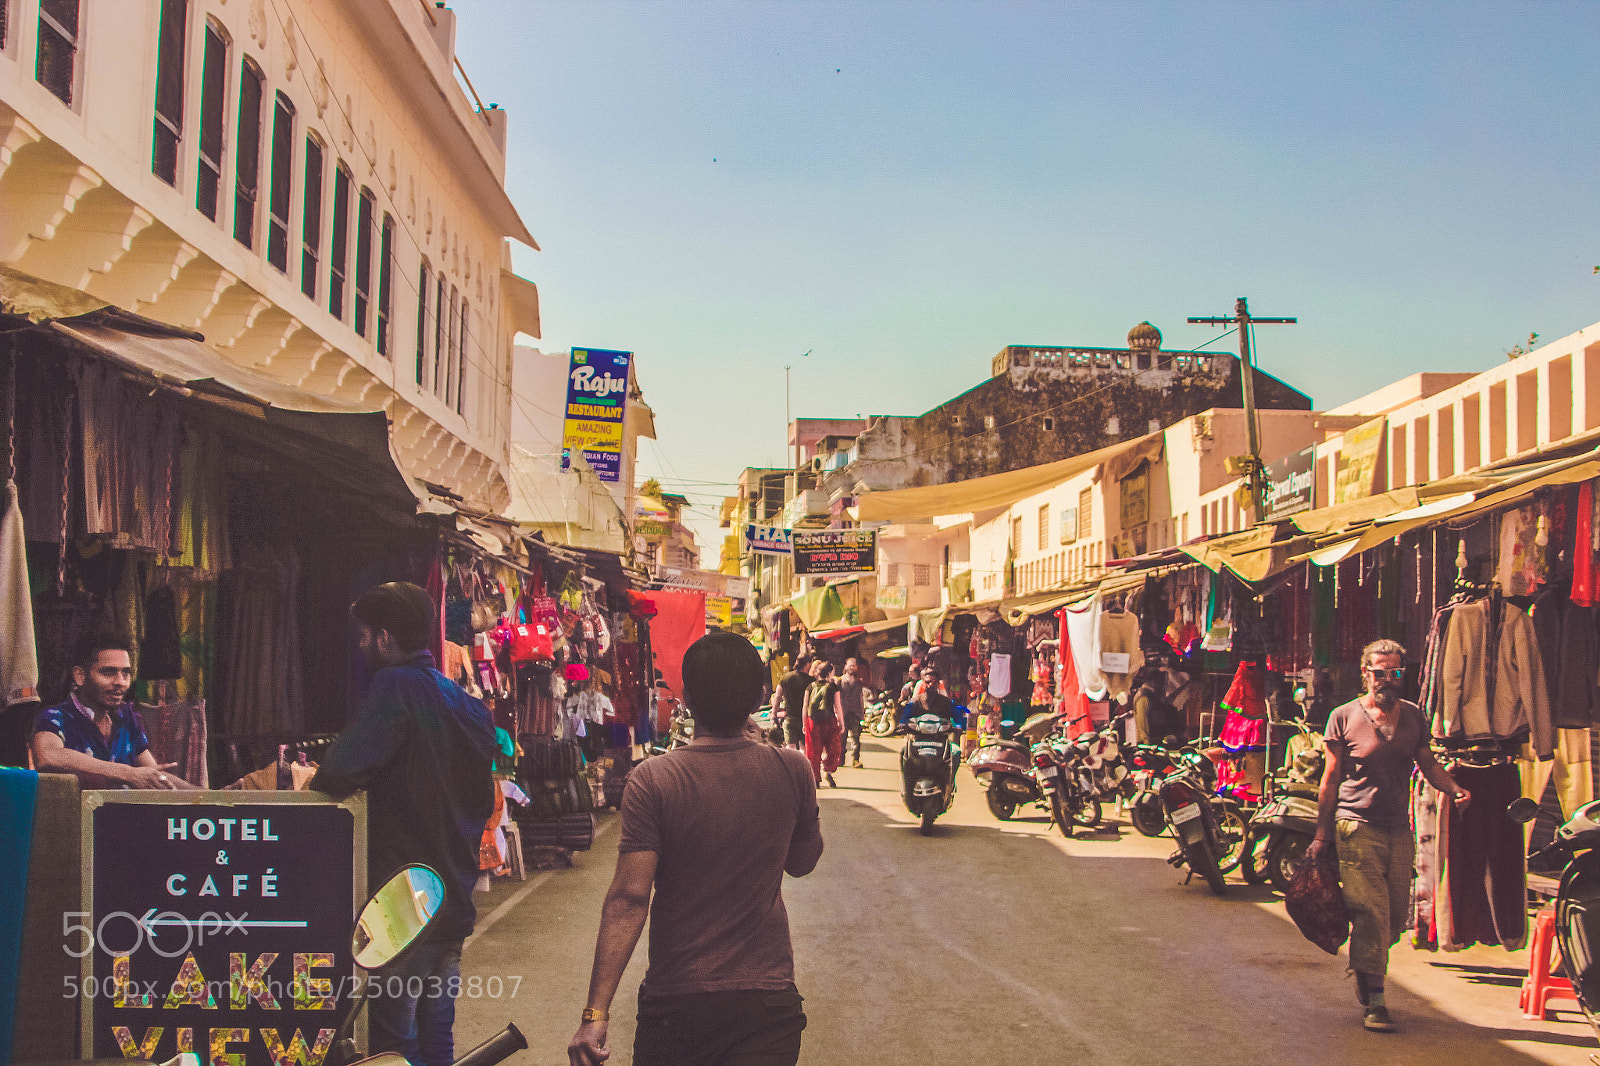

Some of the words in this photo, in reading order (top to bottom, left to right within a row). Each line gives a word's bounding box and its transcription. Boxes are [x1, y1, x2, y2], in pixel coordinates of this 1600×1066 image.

[571, 366, 625, 397] Raju
[568, 404, 622, 418] RESTAURANT
[576, 423, 612, 434] AMAZING
[565, 435, 584, 445] VIEW
[587, 437, 597, 446] OF
[754, 525, 791, 543] RA
[795, 535, 831, 545] SONU
[834, 534, 873, 544] JUICE
[167, 818, 279, 841] HOTEL
[215, 850, 229, 865] &
[166, 868, 279, 897] CAFÉ
[113, 951, 336, 1010] LAKE
